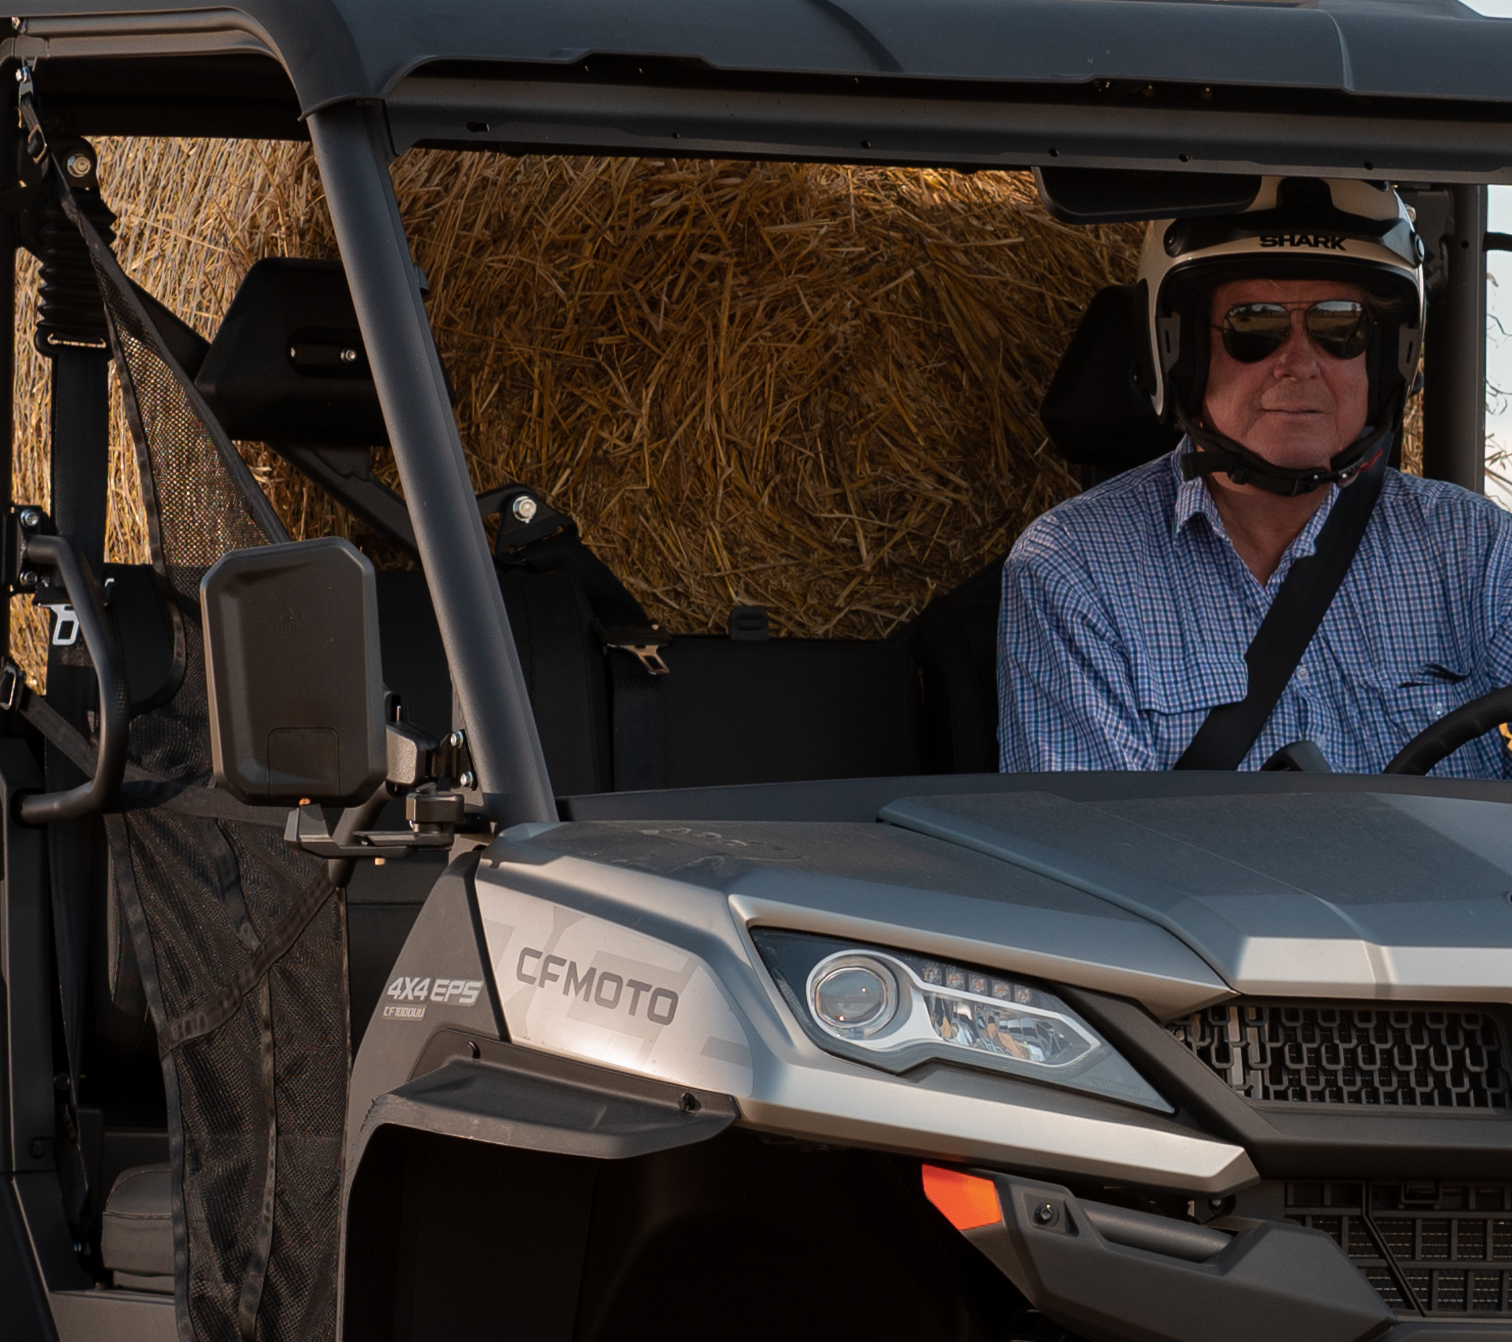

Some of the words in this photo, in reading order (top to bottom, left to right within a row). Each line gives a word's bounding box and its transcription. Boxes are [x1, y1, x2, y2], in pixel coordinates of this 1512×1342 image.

[1259, 235, 1347, 251] SHARK
[387, 976, 430, 1001] 4X4
[430, 979, 484, 1005] EPS
[516, 946, 679, 1026] CFMOTO
